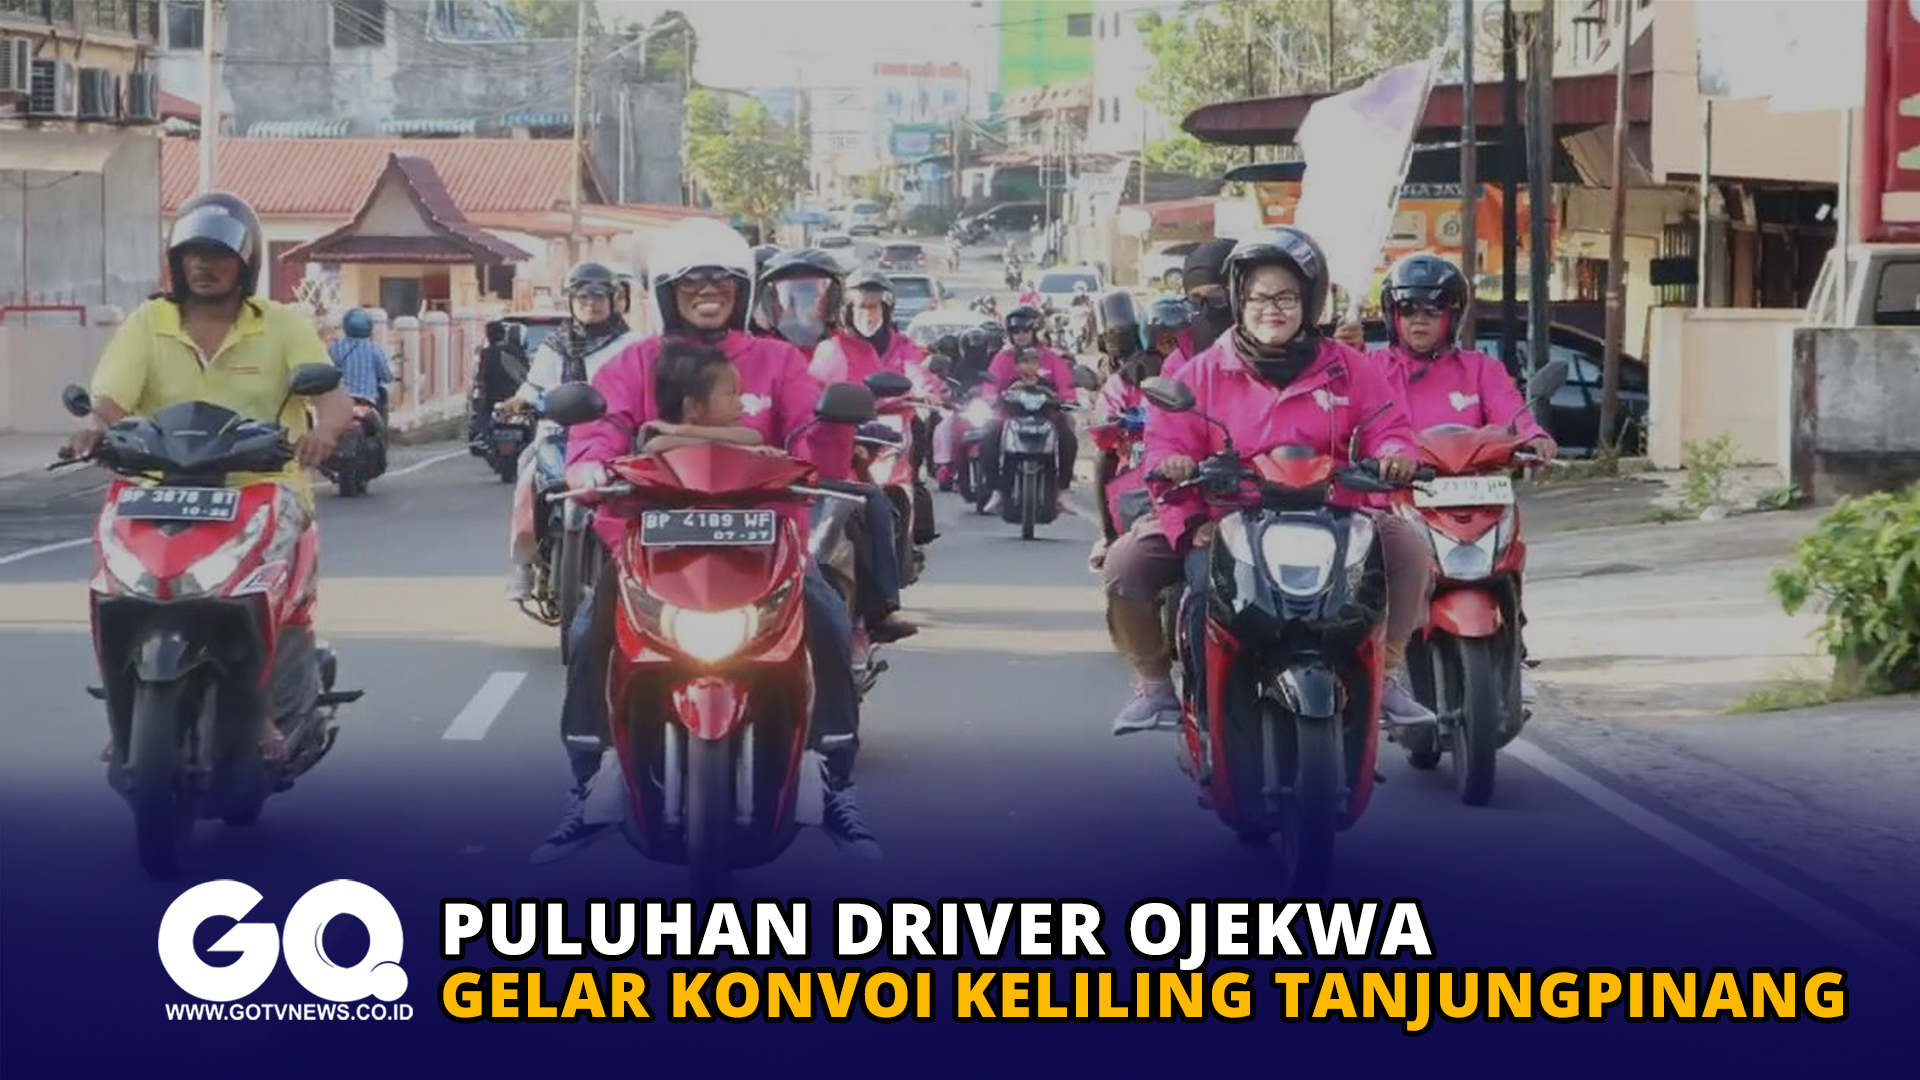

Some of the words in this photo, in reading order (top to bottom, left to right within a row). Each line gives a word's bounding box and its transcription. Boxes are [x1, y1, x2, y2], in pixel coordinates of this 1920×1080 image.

[645, 513, 671, 529] BP
[682, 512, 734, 528] 4189
[743, 512, 771, 528] WF
